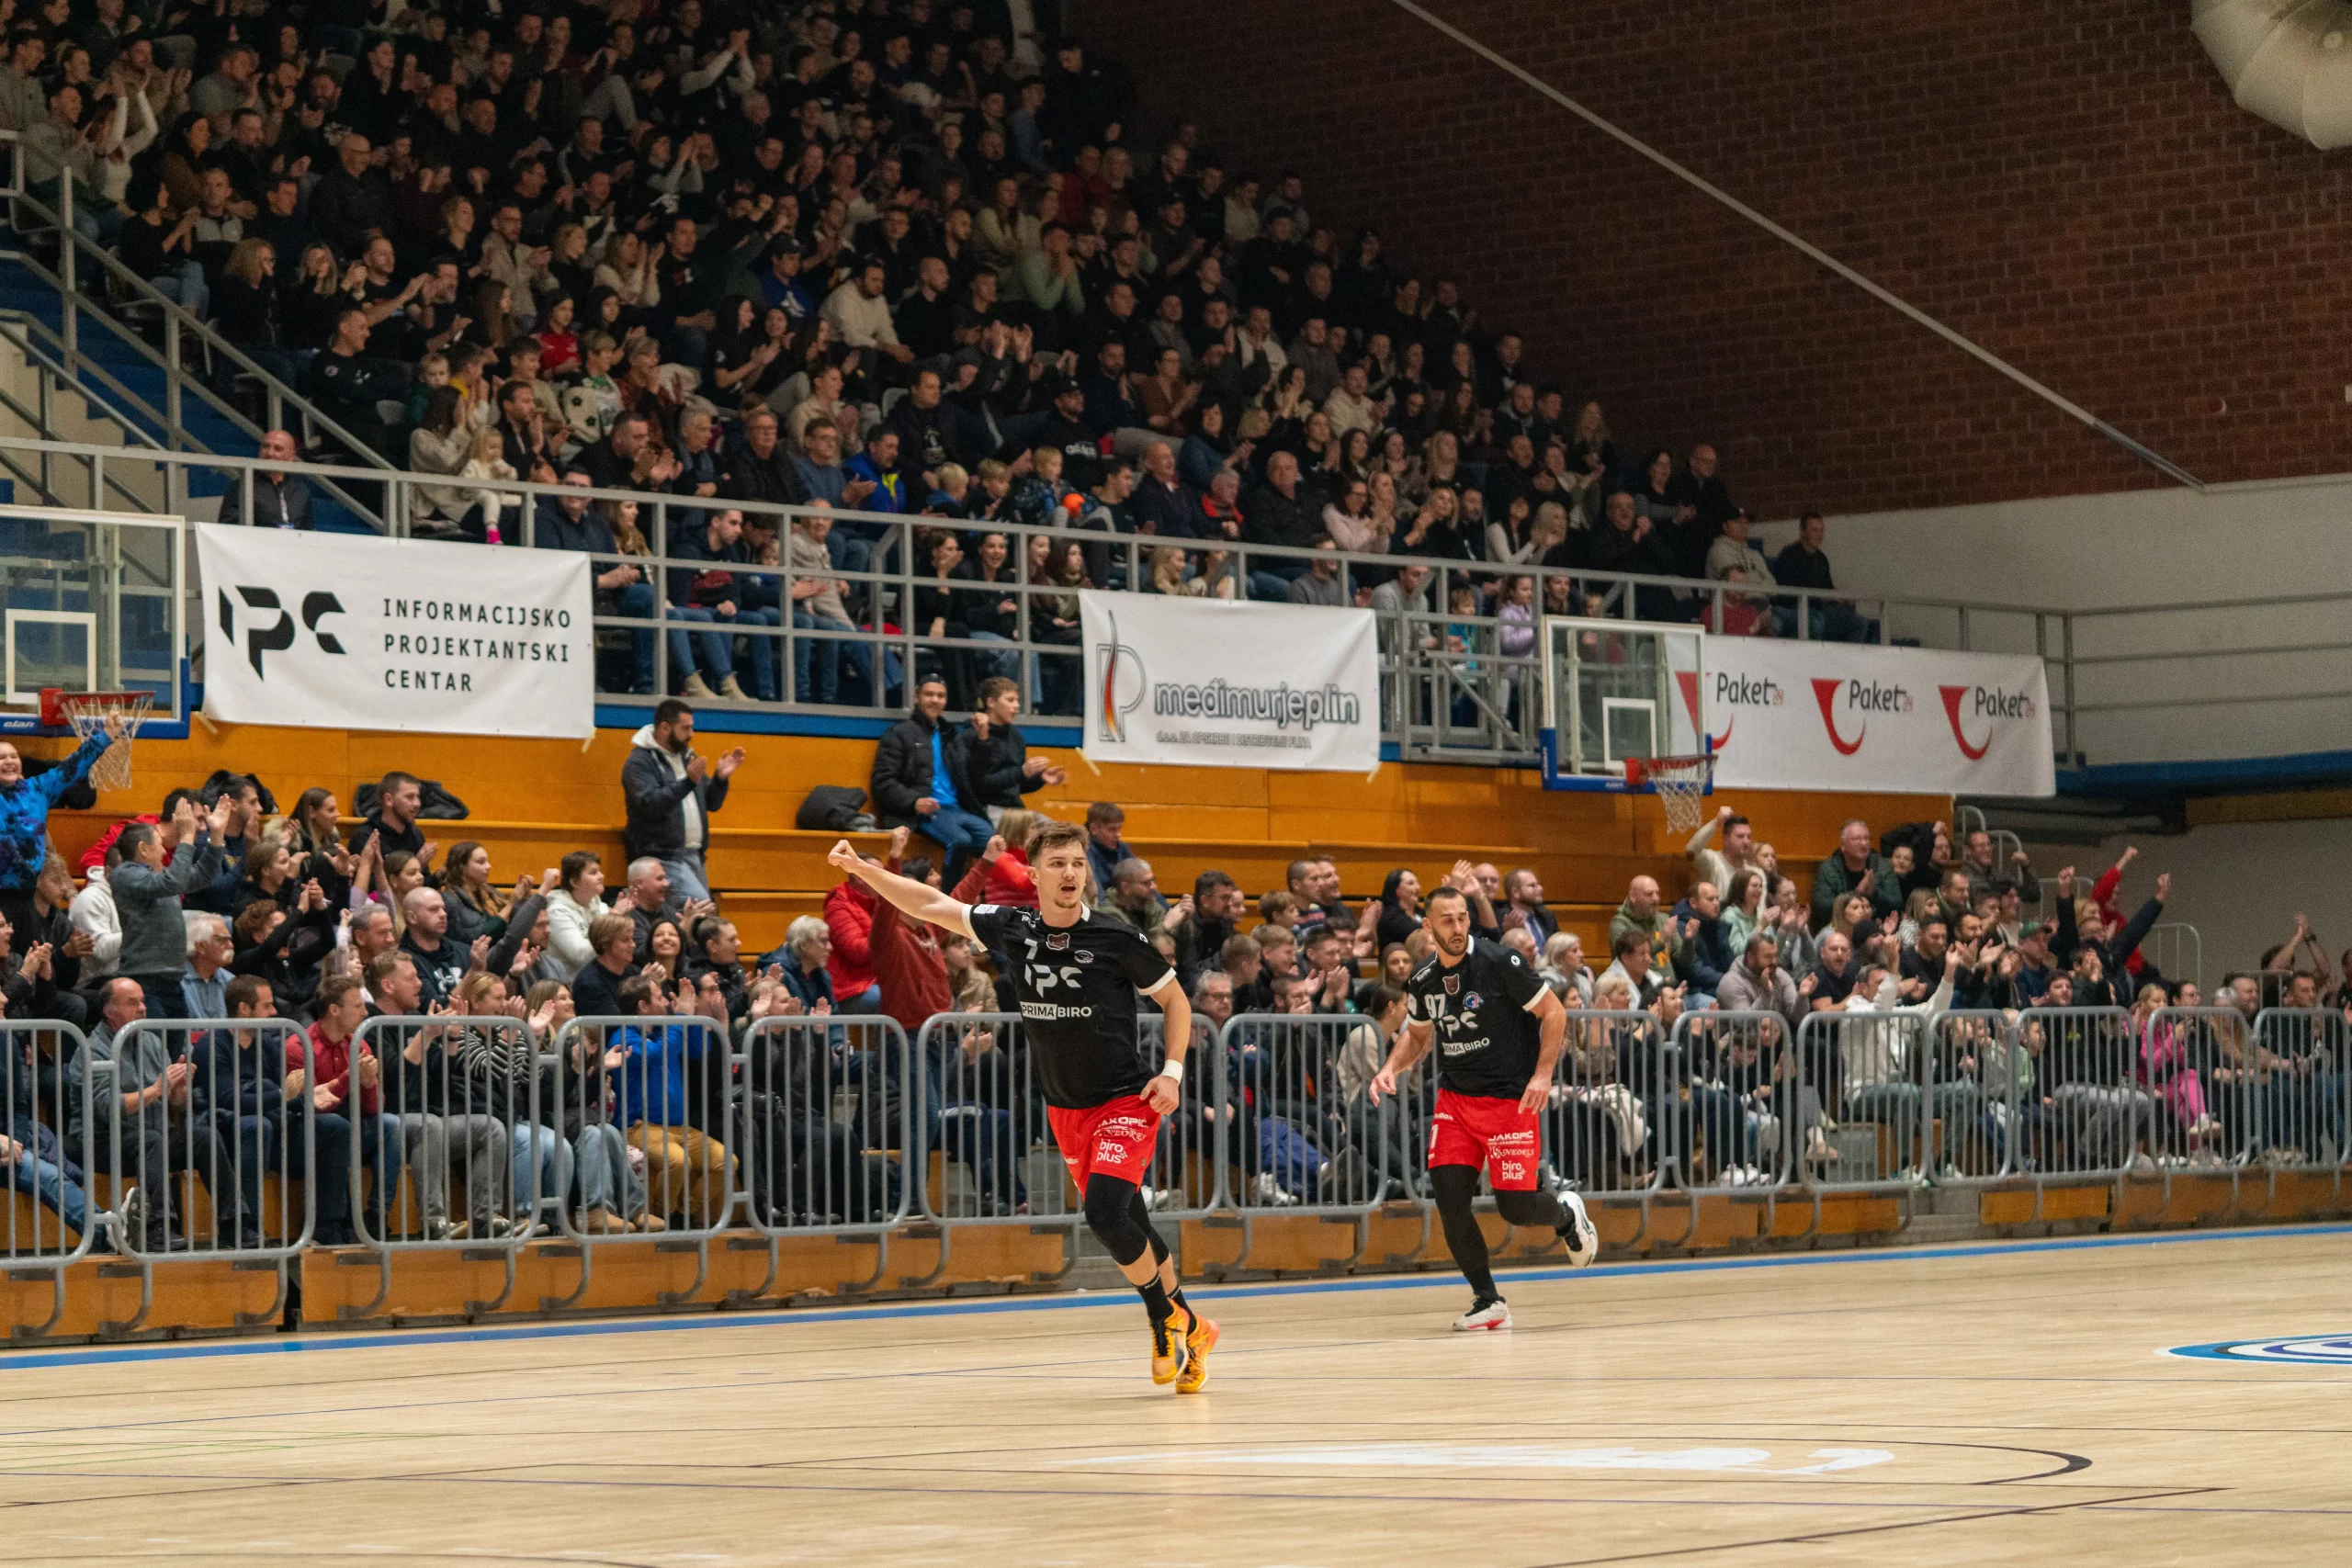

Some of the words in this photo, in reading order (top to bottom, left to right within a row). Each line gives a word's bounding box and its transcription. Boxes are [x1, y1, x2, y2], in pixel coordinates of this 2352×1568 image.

[383, 598, 571, 628] INFORMACIJSKO
[384, 634, 570, 662] PROJEKTANTSKI
[385, 669, 473, 692] CENTAR
[1024, 938, 1038, 960] 7
[1424, 993, 1446, 1020] 97
[1100, 1138, 1124, 1153] biro
[1502, 1160, 1522, 1171] biro
